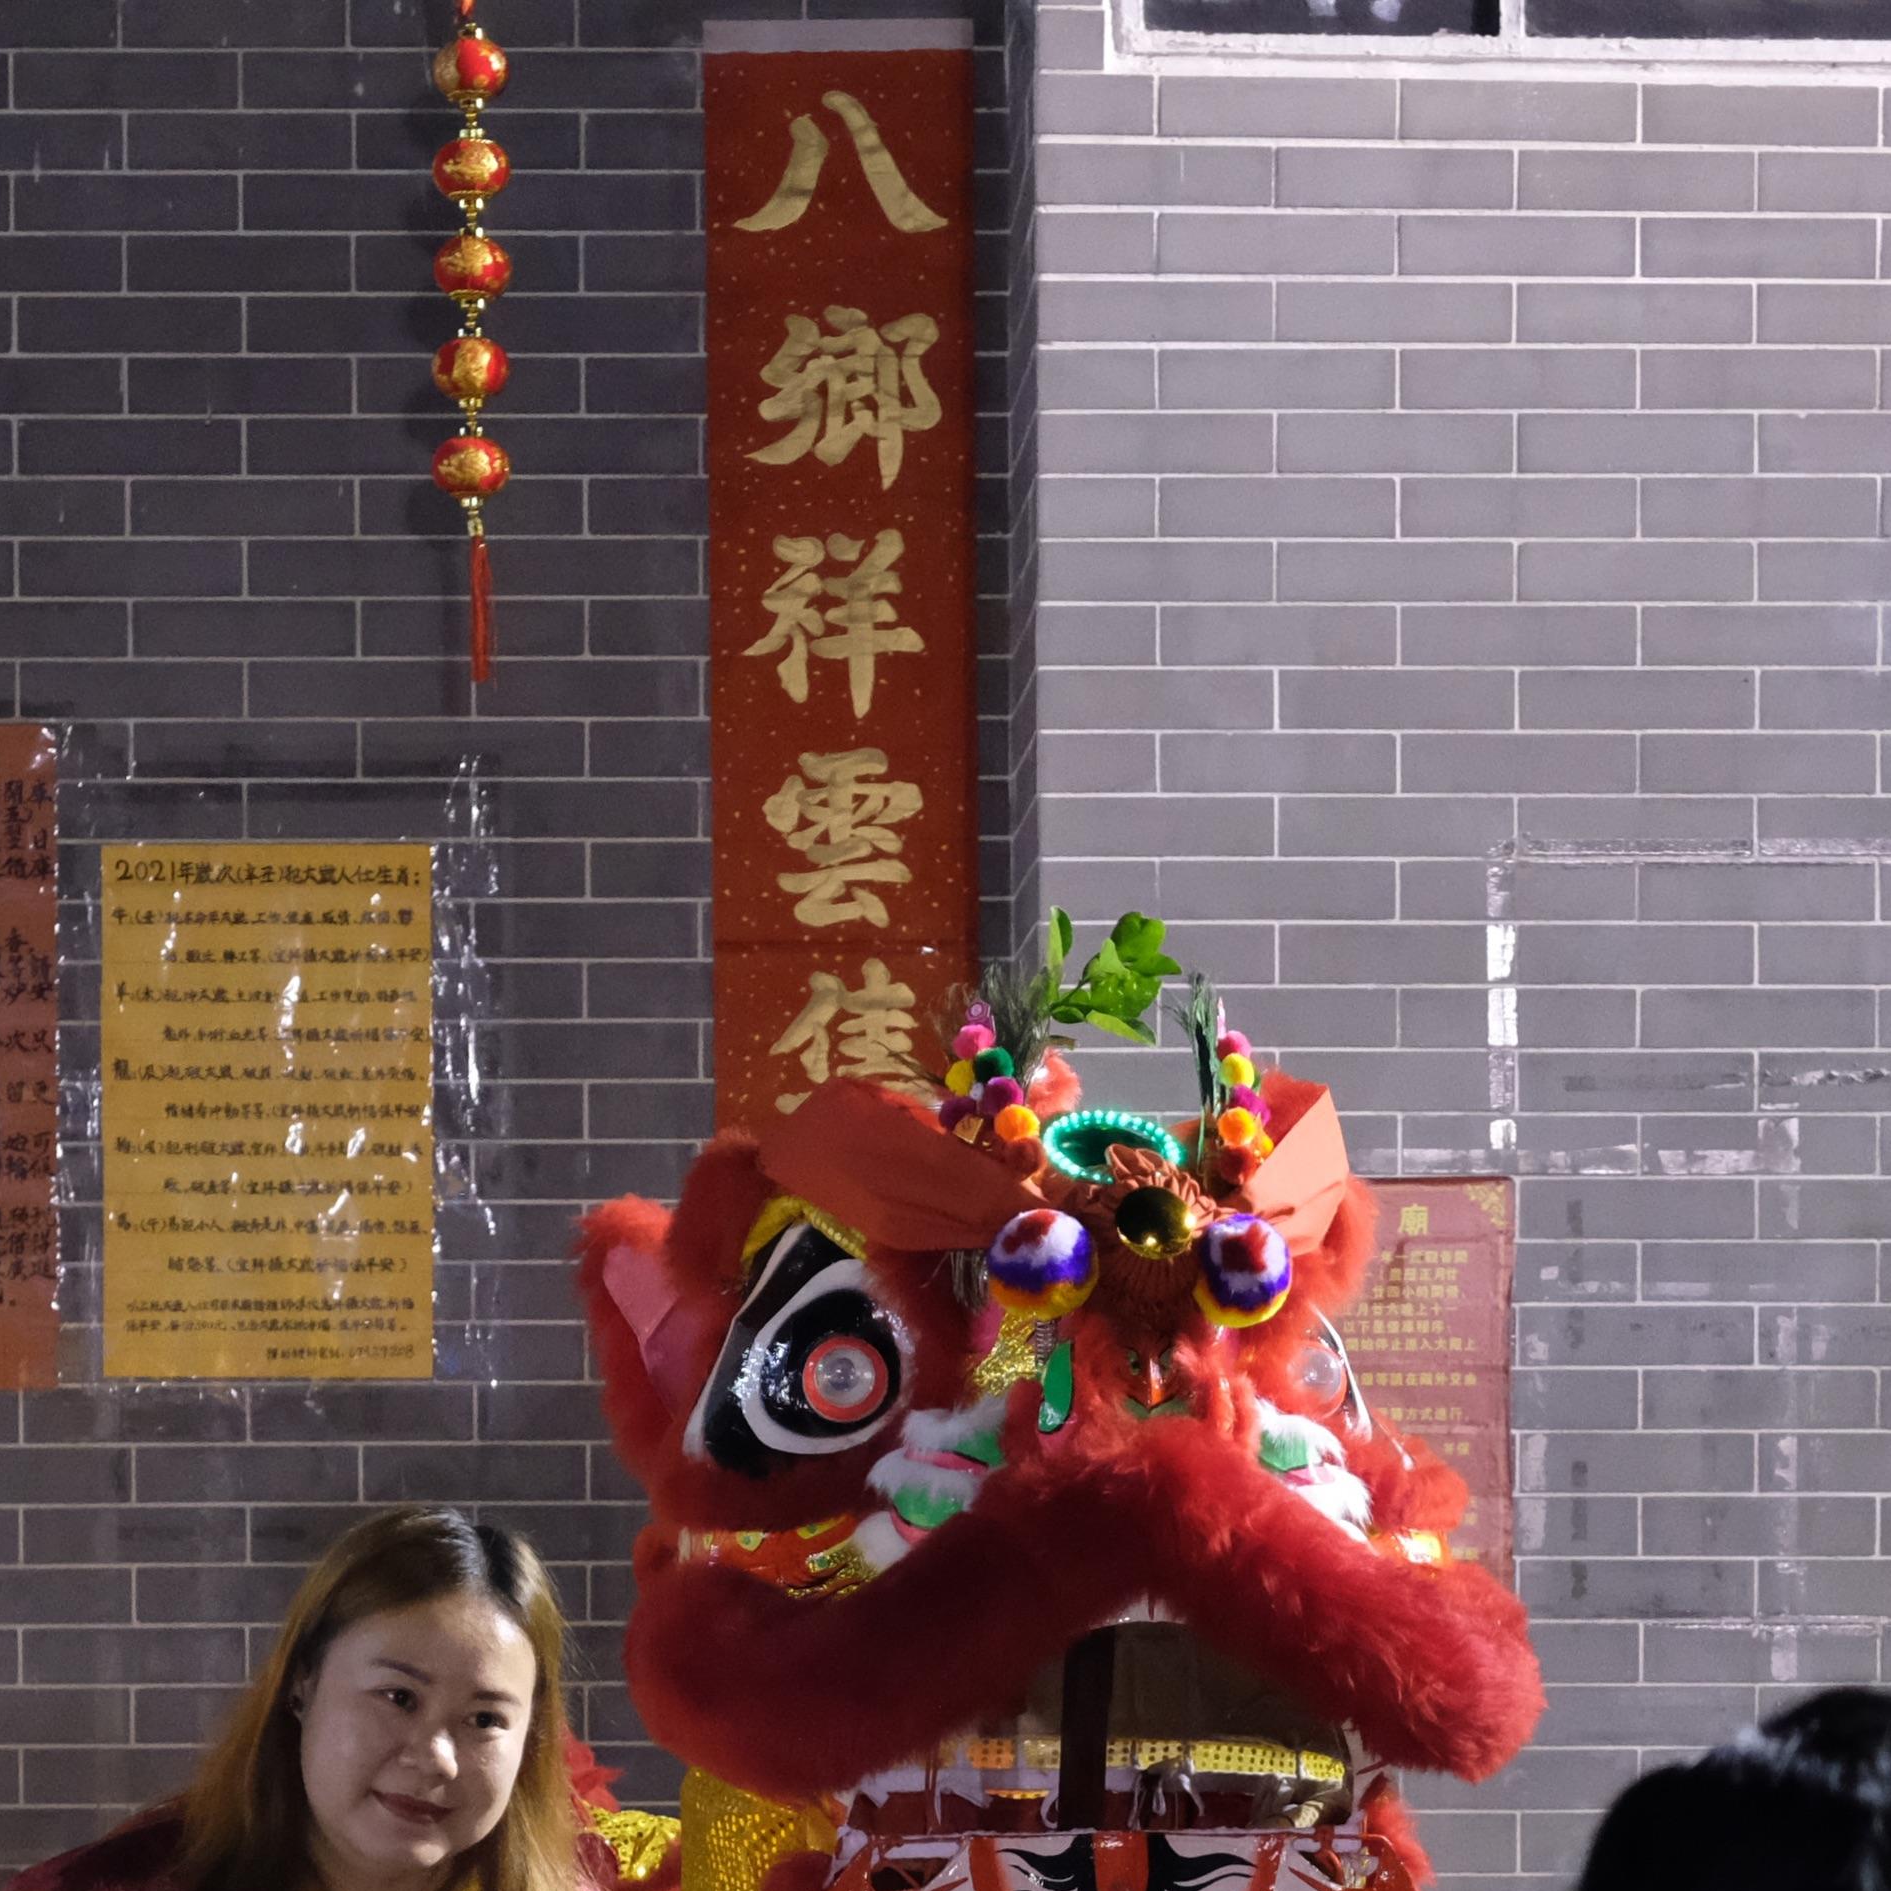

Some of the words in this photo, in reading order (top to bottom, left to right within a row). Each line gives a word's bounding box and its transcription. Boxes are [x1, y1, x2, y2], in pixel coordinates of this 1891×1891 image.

[731, 89, 947, 1115] 八鄉祥雲佳
[1398, 1203, 1429, 1236] 廟
